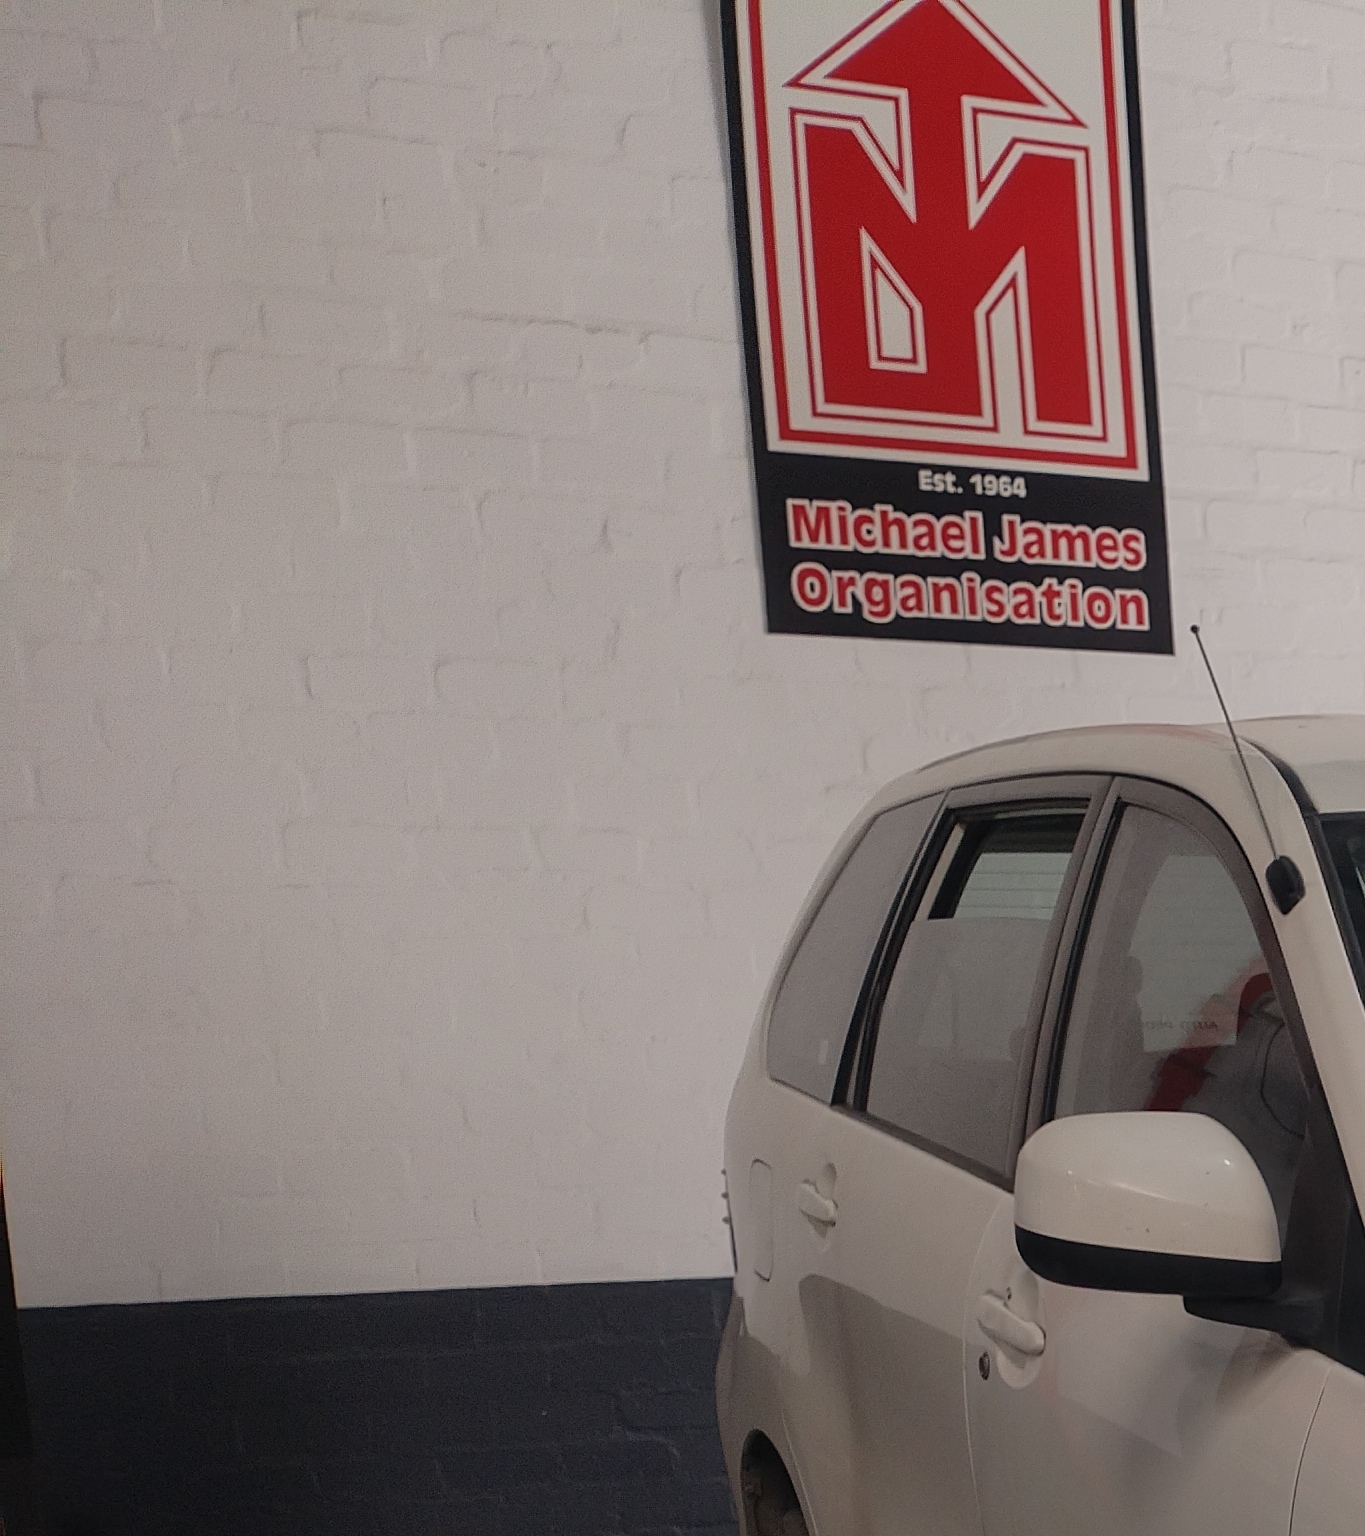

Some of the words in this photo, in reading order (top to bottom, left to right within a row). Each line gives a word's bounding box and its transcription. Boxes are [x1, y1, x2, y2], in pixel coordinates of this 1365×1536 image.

[918, 469, 964, 495] Est.
[969, 473, 1027, 499] 1964
[786, 498, 983, 557] Michael
[993, 514, 1147, 572] James
[790, 562, 1151, 631] Organisation
